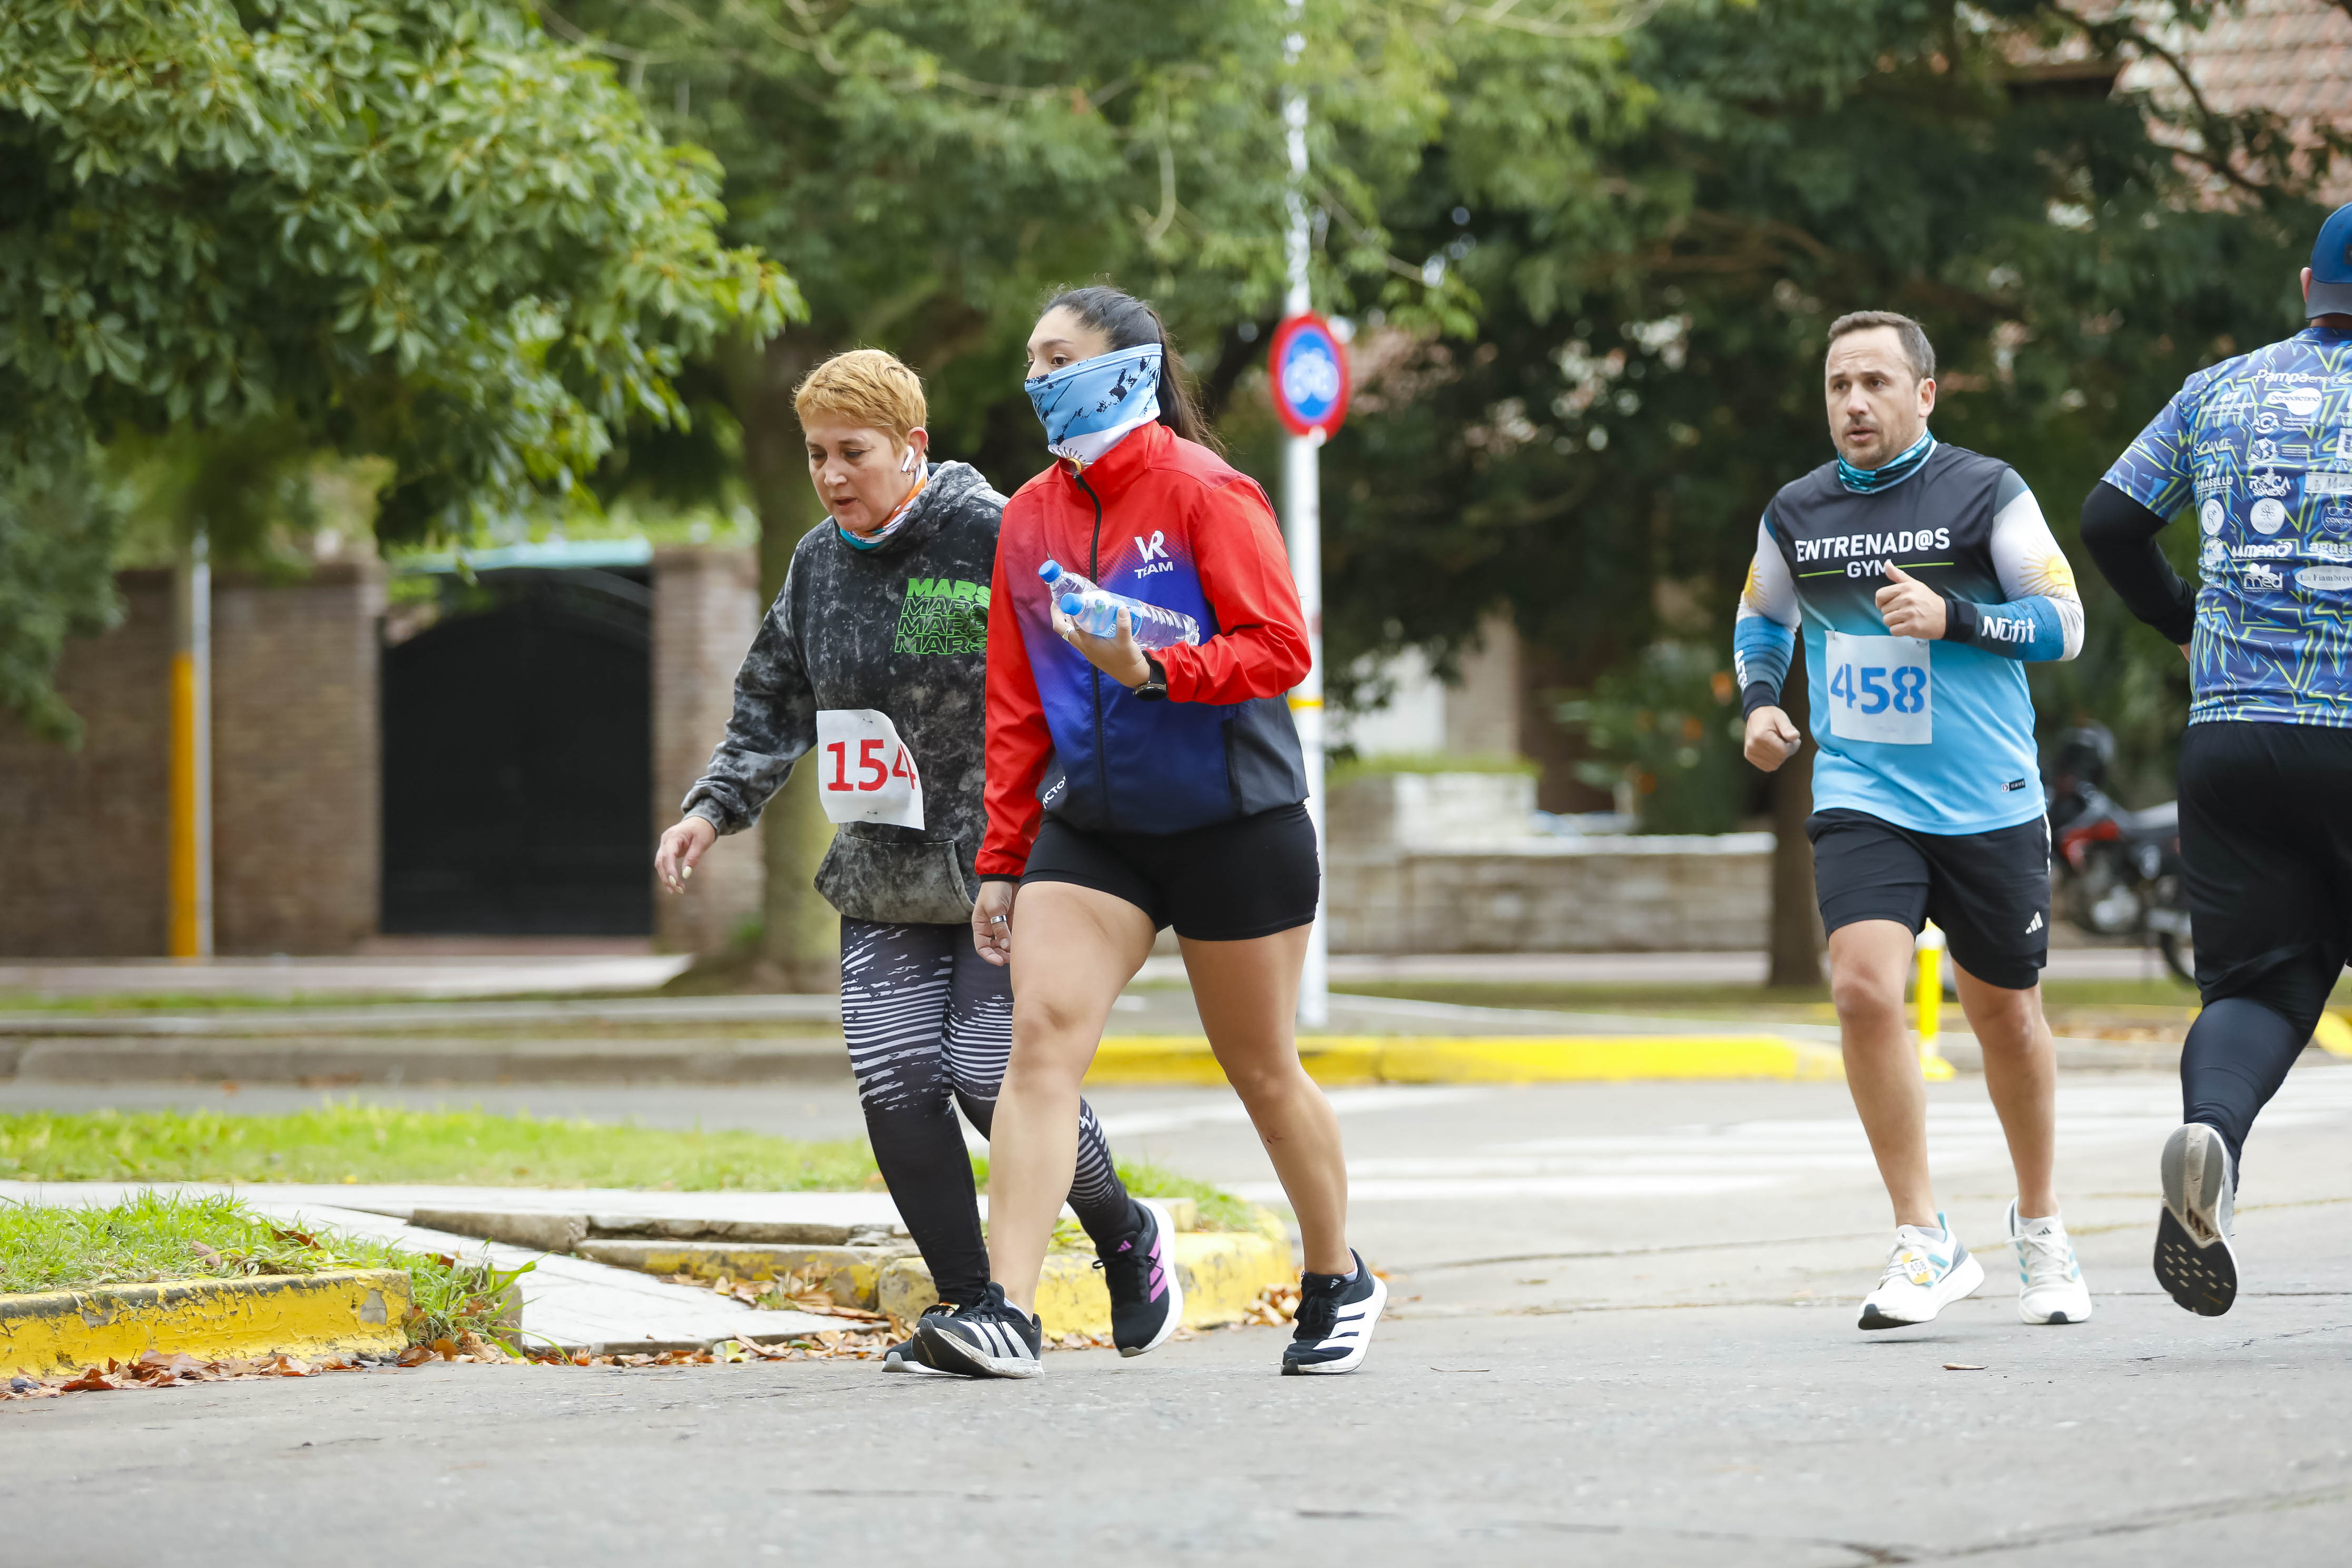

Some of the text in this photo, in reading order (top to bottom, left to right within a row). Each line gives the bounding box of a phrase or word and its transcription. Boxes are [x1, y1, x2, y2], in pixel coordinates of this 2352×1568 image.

[1795, 527, 1951, 563] ENTRENAD@S
[1134, 561, 1174, 579] TEAM
[2314, 573, 2352, 582] Fiambrer
[906, 578, 992, 607] MARS
[1830, 663, 1927, 715] 458
[827, 739, 916, 792] 154
[1042, 776, 1066, 809] ICTO
